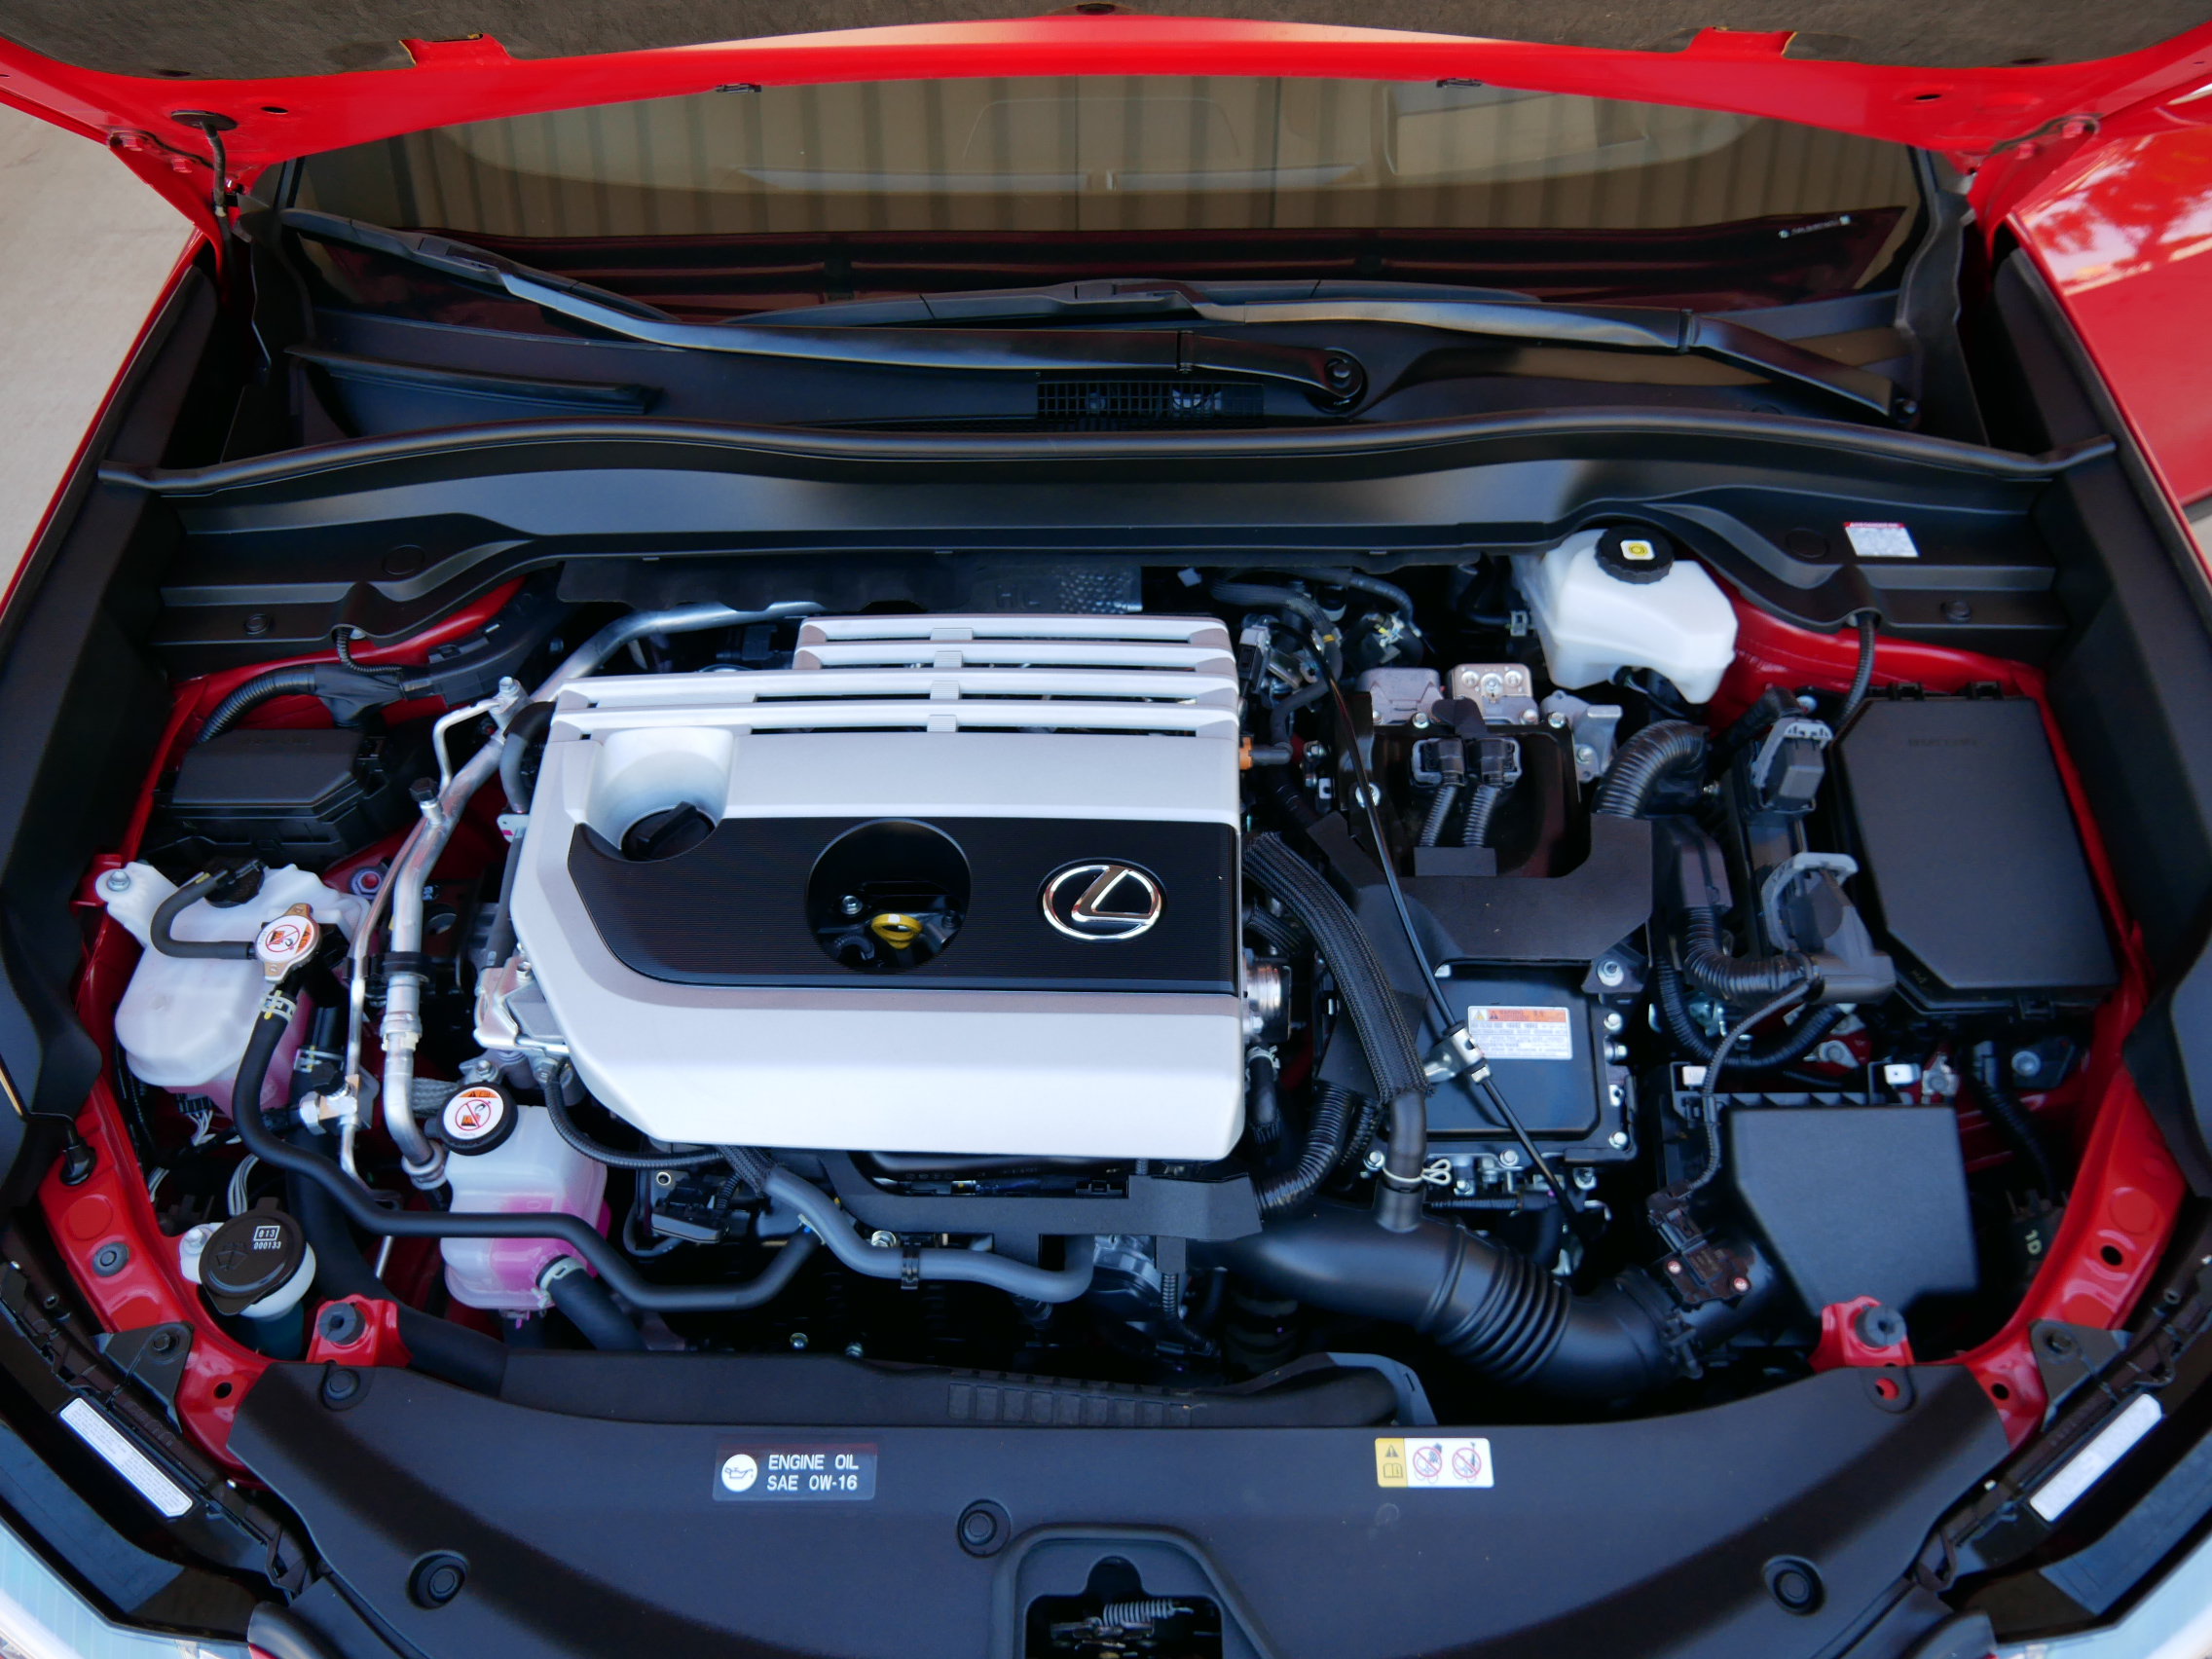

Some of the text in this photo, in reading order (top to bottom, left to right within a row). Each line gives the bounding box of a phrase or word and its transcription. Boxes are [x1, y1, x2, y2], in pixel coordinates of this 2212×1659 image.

[253, 1240, 281, 1250] 000133
[768, 1454, 859, 1471] ENGINE OIL
[766, 1474, 859, 1492] SAE 0W-16
